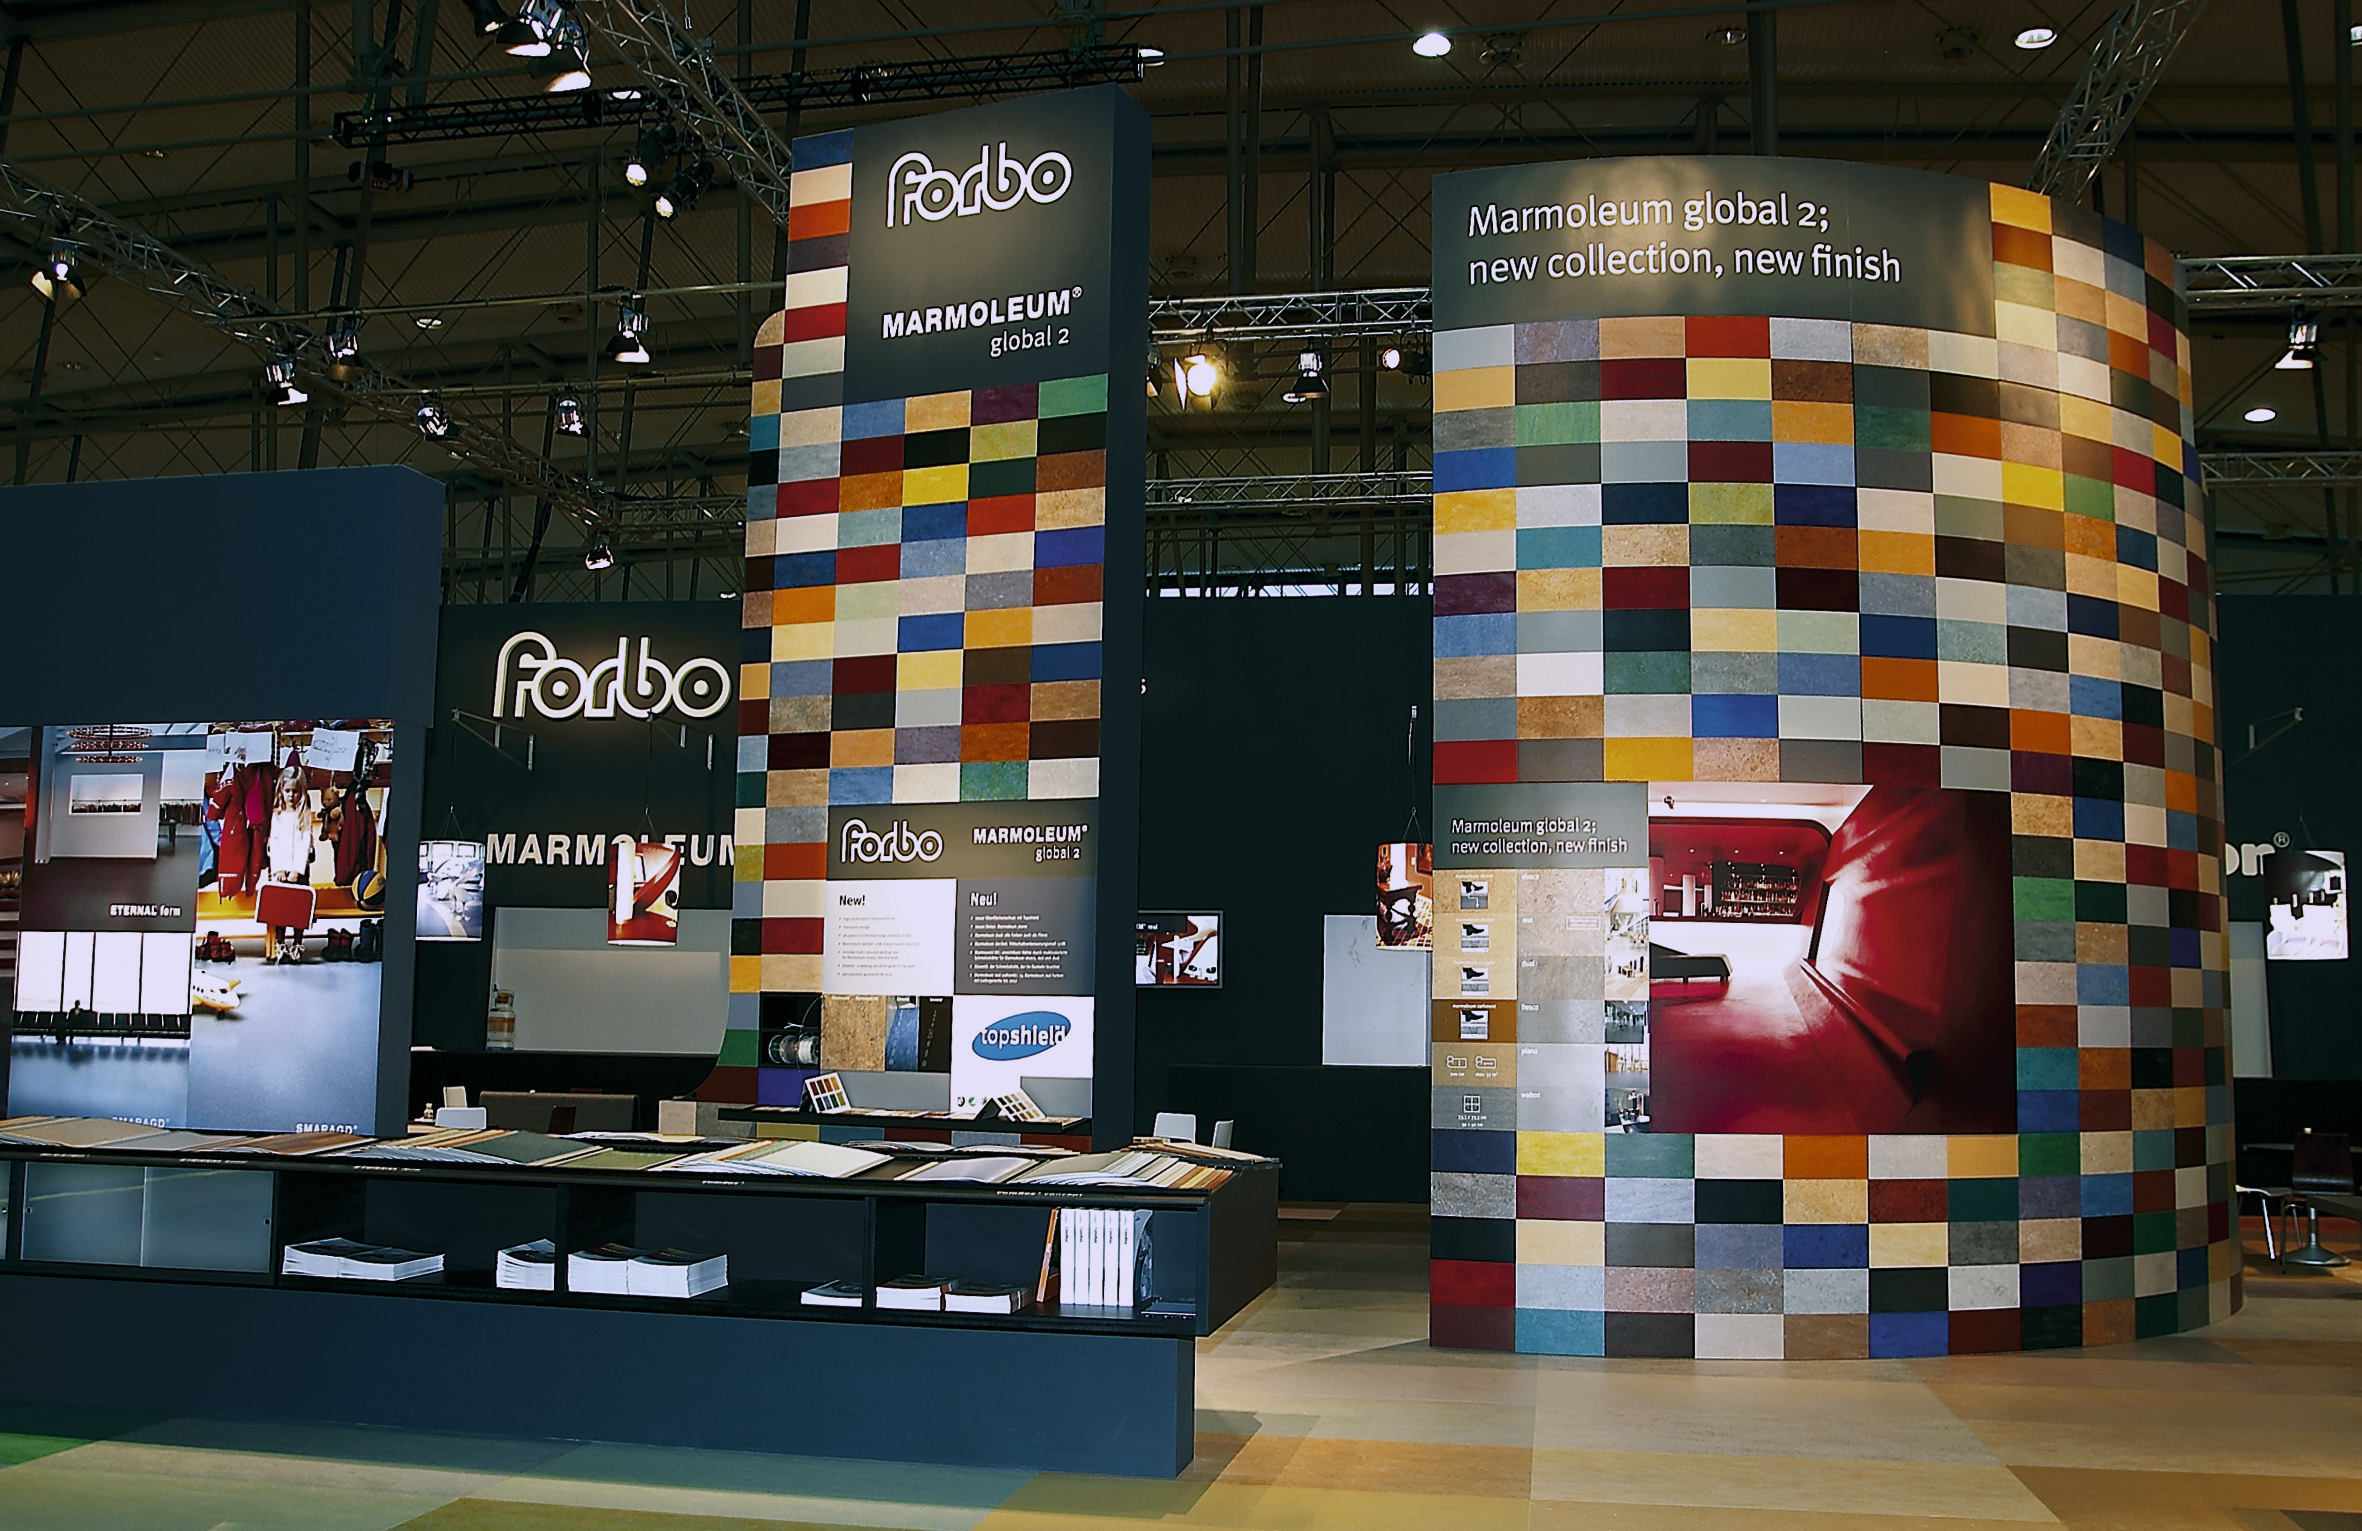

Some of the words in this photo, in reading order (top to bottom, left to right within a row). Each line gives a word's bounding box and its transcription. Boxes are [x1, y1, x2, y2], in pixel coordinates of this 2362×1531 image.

[1468, 194, 1673, 237] Marmoleum
[1683, 191, 1790, 232] global
[1798, 202, 1831, 233] 2;
[1469, 255, 1538, 285] new
[1546, 241, 1724, 280] collection,
[1734, 249, 1804, 275] new
[1811, 243, 1903, 284] finish
[989, 325, 1053, 357] global
[1057, 328, 1071, 346] 2
[1450, 818, 1534, 835] Marmoleum
[1536, 817, 1581, 836] global
[1034, 846, 1071, 862] global
[1072, 848, 1081, 860] 2
[1450, 840, 1481, 855] new
[1481, 838, 1553, 857] collection,
[1554, 839, 1585, 854] new
[1587, 837, 1629, 854] finish
[839, 894, 866, 907] New!
[970, 892, 998, 907] Neu!
[159, 904, 181, 917] form
